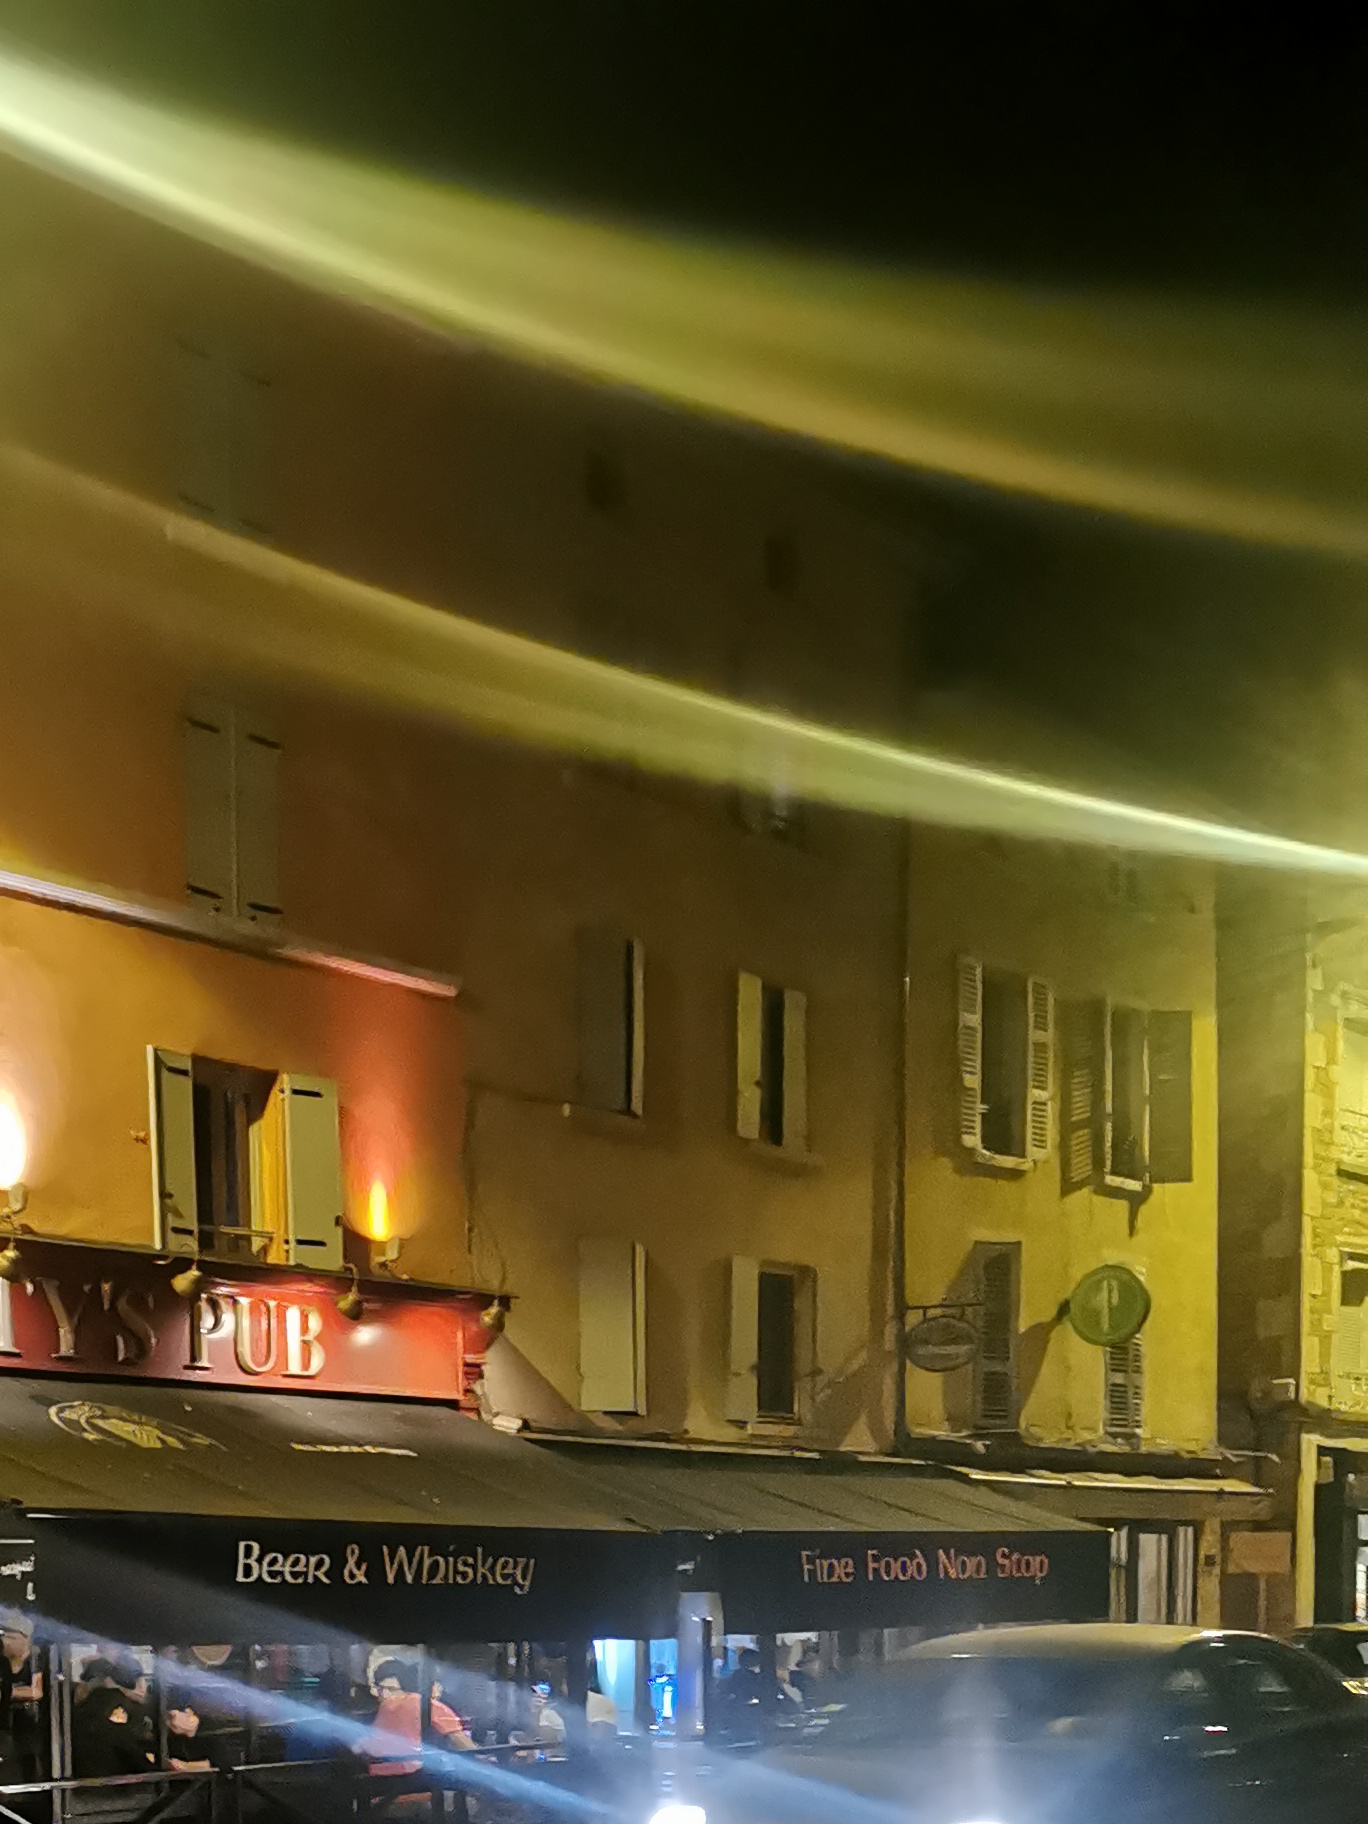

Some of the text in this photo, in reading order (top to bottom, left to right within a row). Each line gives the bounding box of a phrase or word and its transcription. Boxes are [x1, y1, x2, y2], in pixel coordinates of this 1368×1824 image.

[183, 1292, 326, 1377] PUB
[235, 1540, 537, 1595] Beer & Whiskey
[800, 1547, 1050, 1585] Fine Food Non Stop
